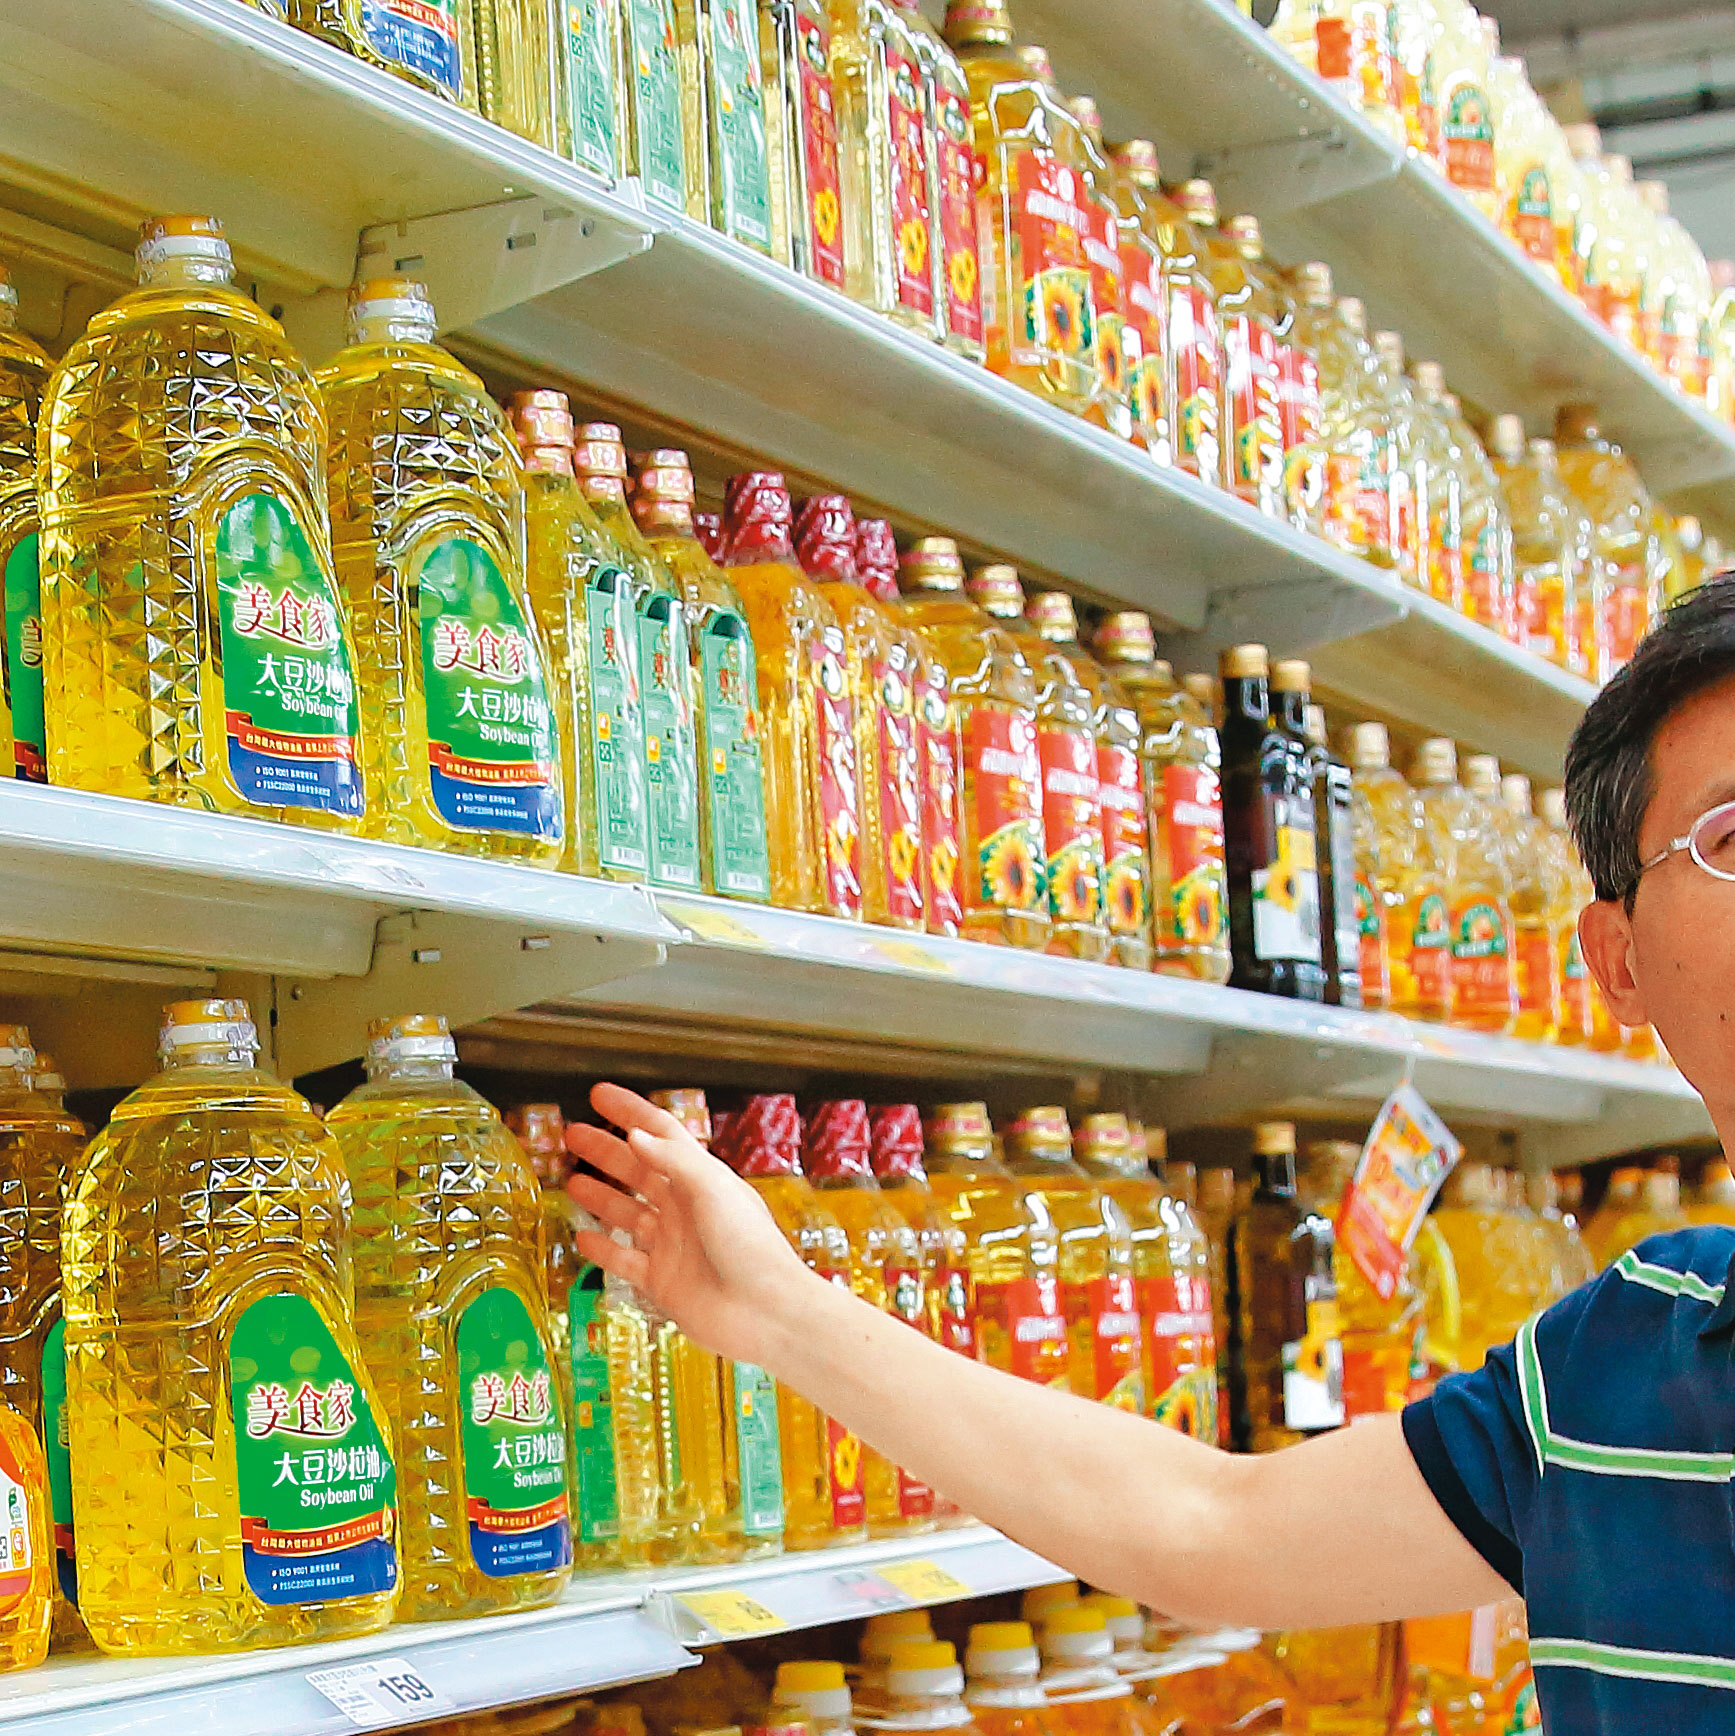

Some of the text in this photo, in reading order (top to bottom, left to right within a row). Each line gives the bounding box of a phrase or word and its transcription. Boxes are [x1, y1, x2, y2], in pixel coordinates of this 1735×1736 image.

[233, 581, 331, 650] 美食家
[433, 620, 528, 684] 美食家
[281, 693, 333, 719] Soybean
[479, 723, 530, 747] Soybean
[247, 1379, 355, 1439] 美食家
[472, 1370, 552, 1427] 美食家
[272, 1444, 381, 1487] 大豆沙拉油
[493, 1432, 566, 1470] 大豆沙拉
[300, 1482, 375, 1511] Soybean Oil
[378, 1672, 436, 1704] 159
